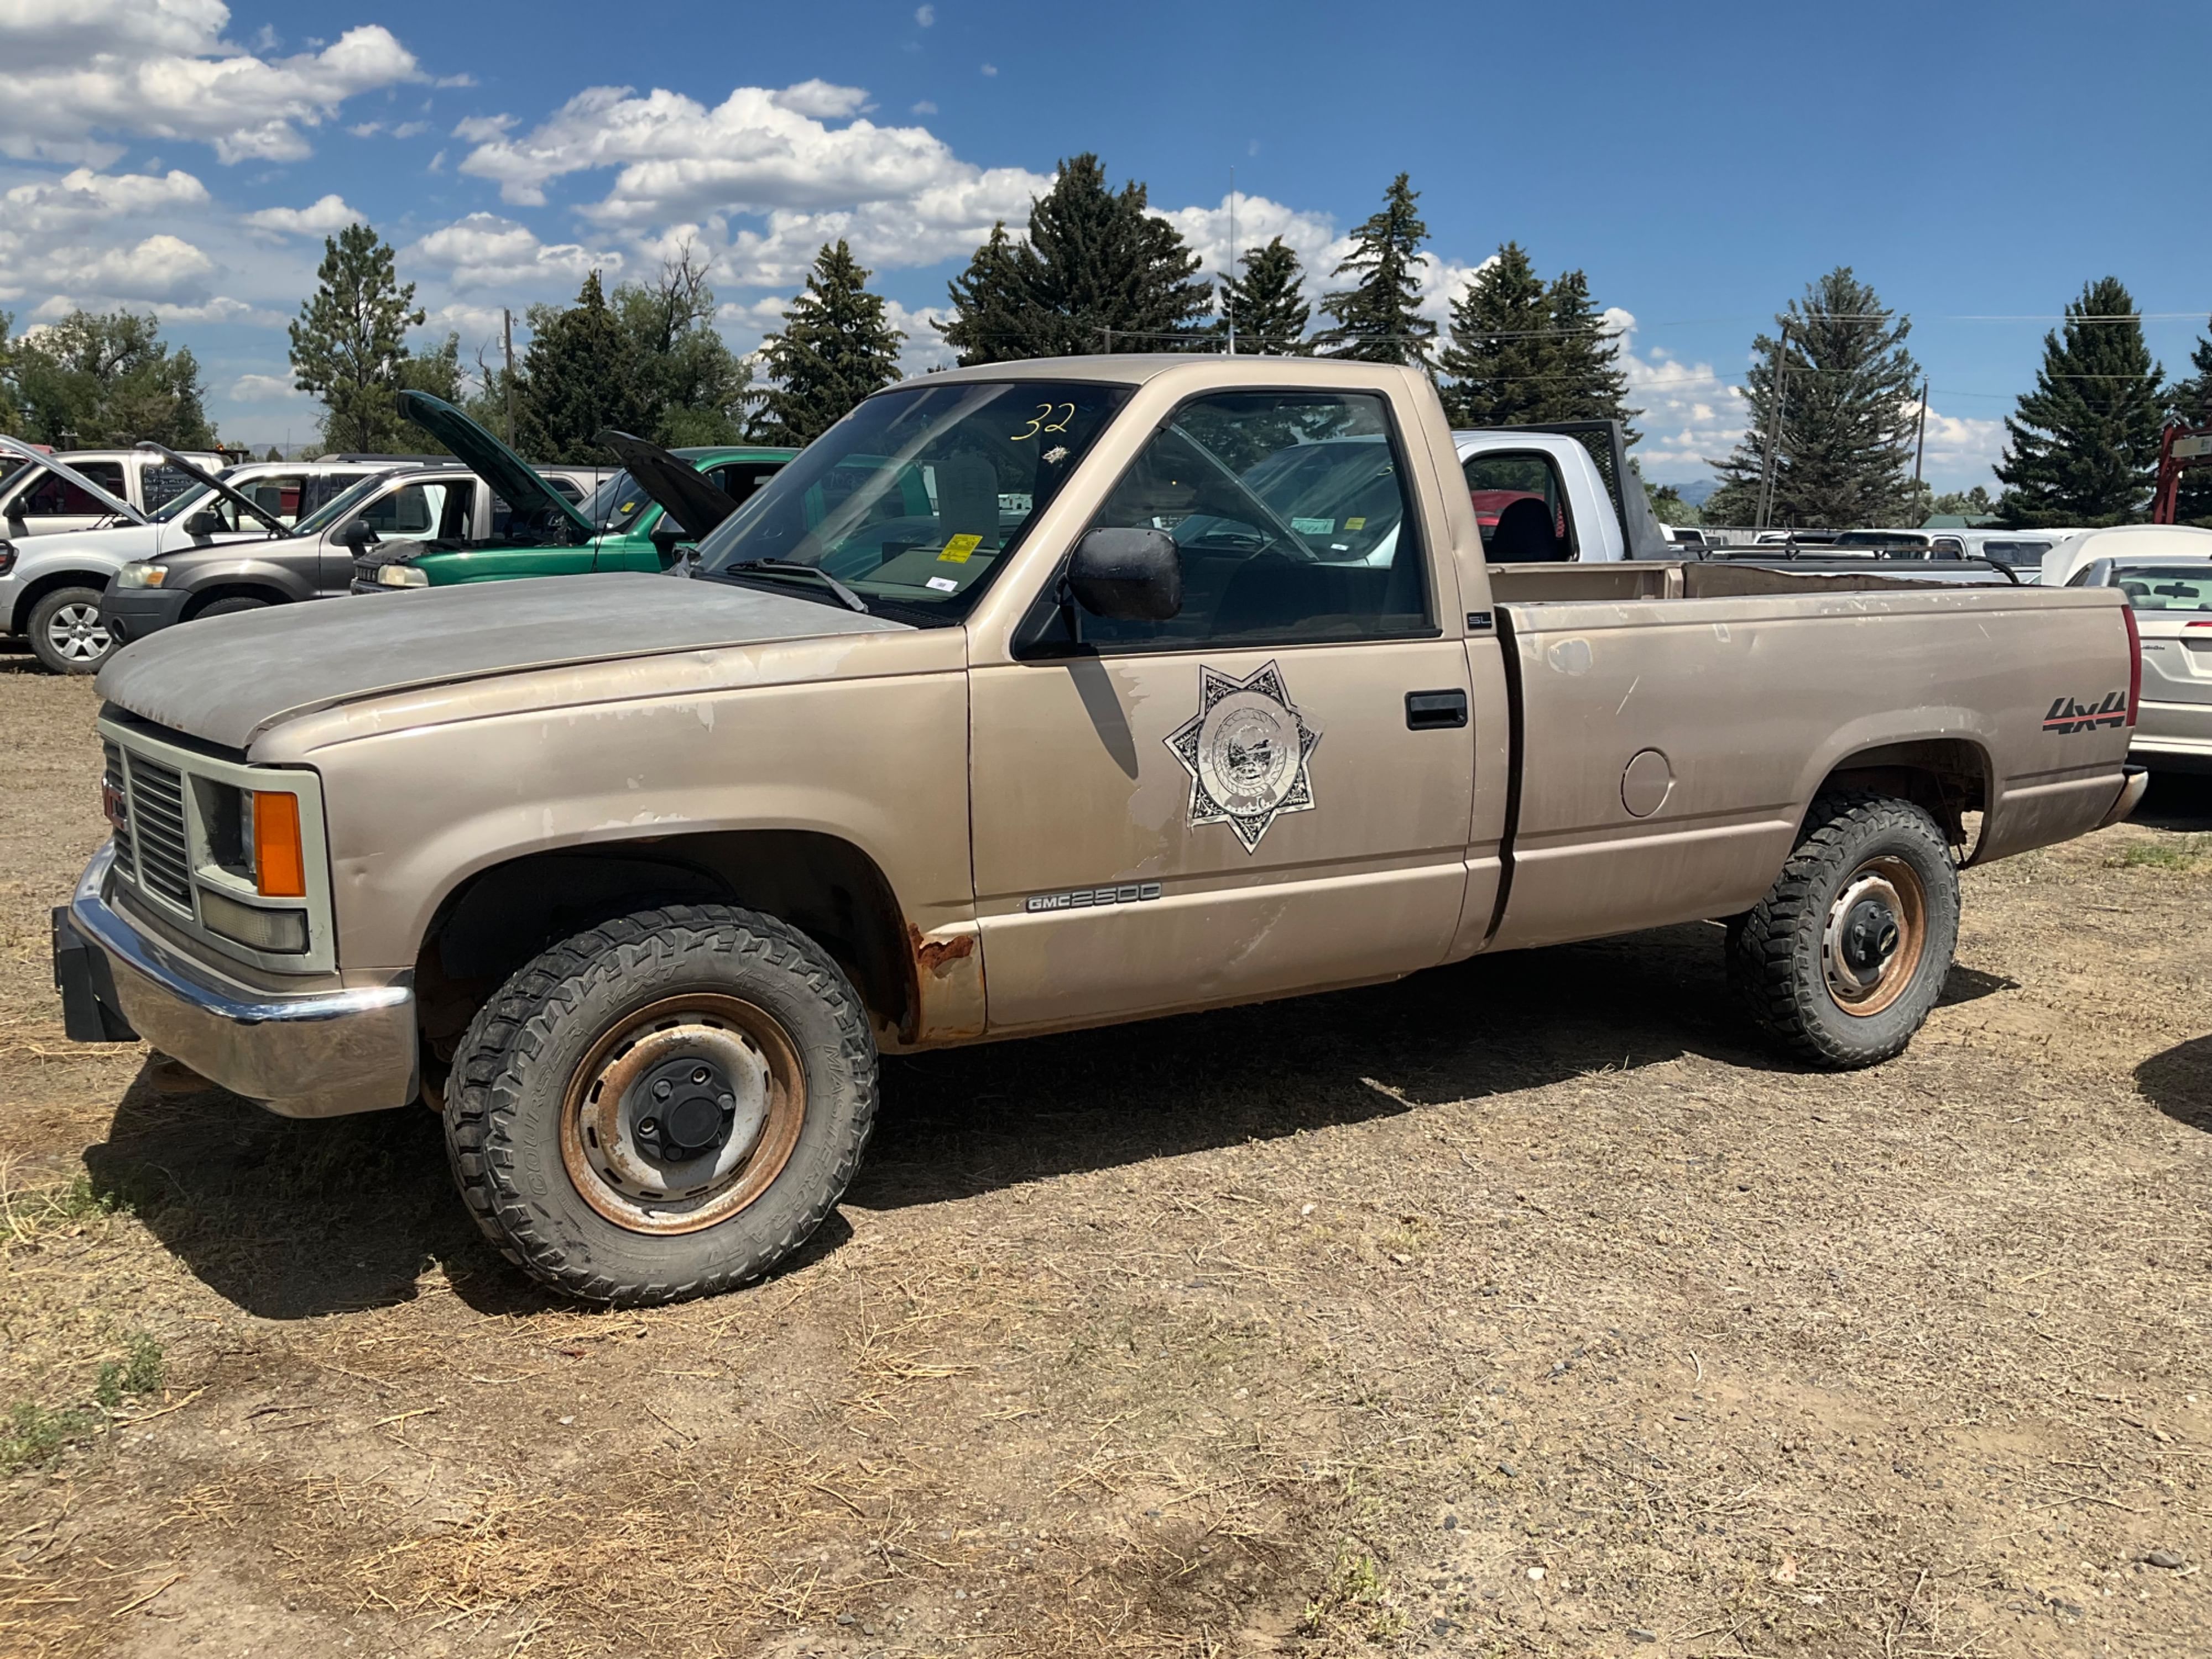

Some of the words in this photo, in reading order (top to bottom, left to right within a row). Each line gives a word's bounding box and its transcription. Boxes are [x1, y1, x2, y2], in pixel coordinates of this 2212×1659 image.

[1010, 403, 1074, 441] 32
[1468, 615, 1491, 624] SL
[524, 1019, 583, 1195] COURSER
[599, 960, 686, 1014] MXT
[700, 1044, 846, 1270] MASTERCRAFT
